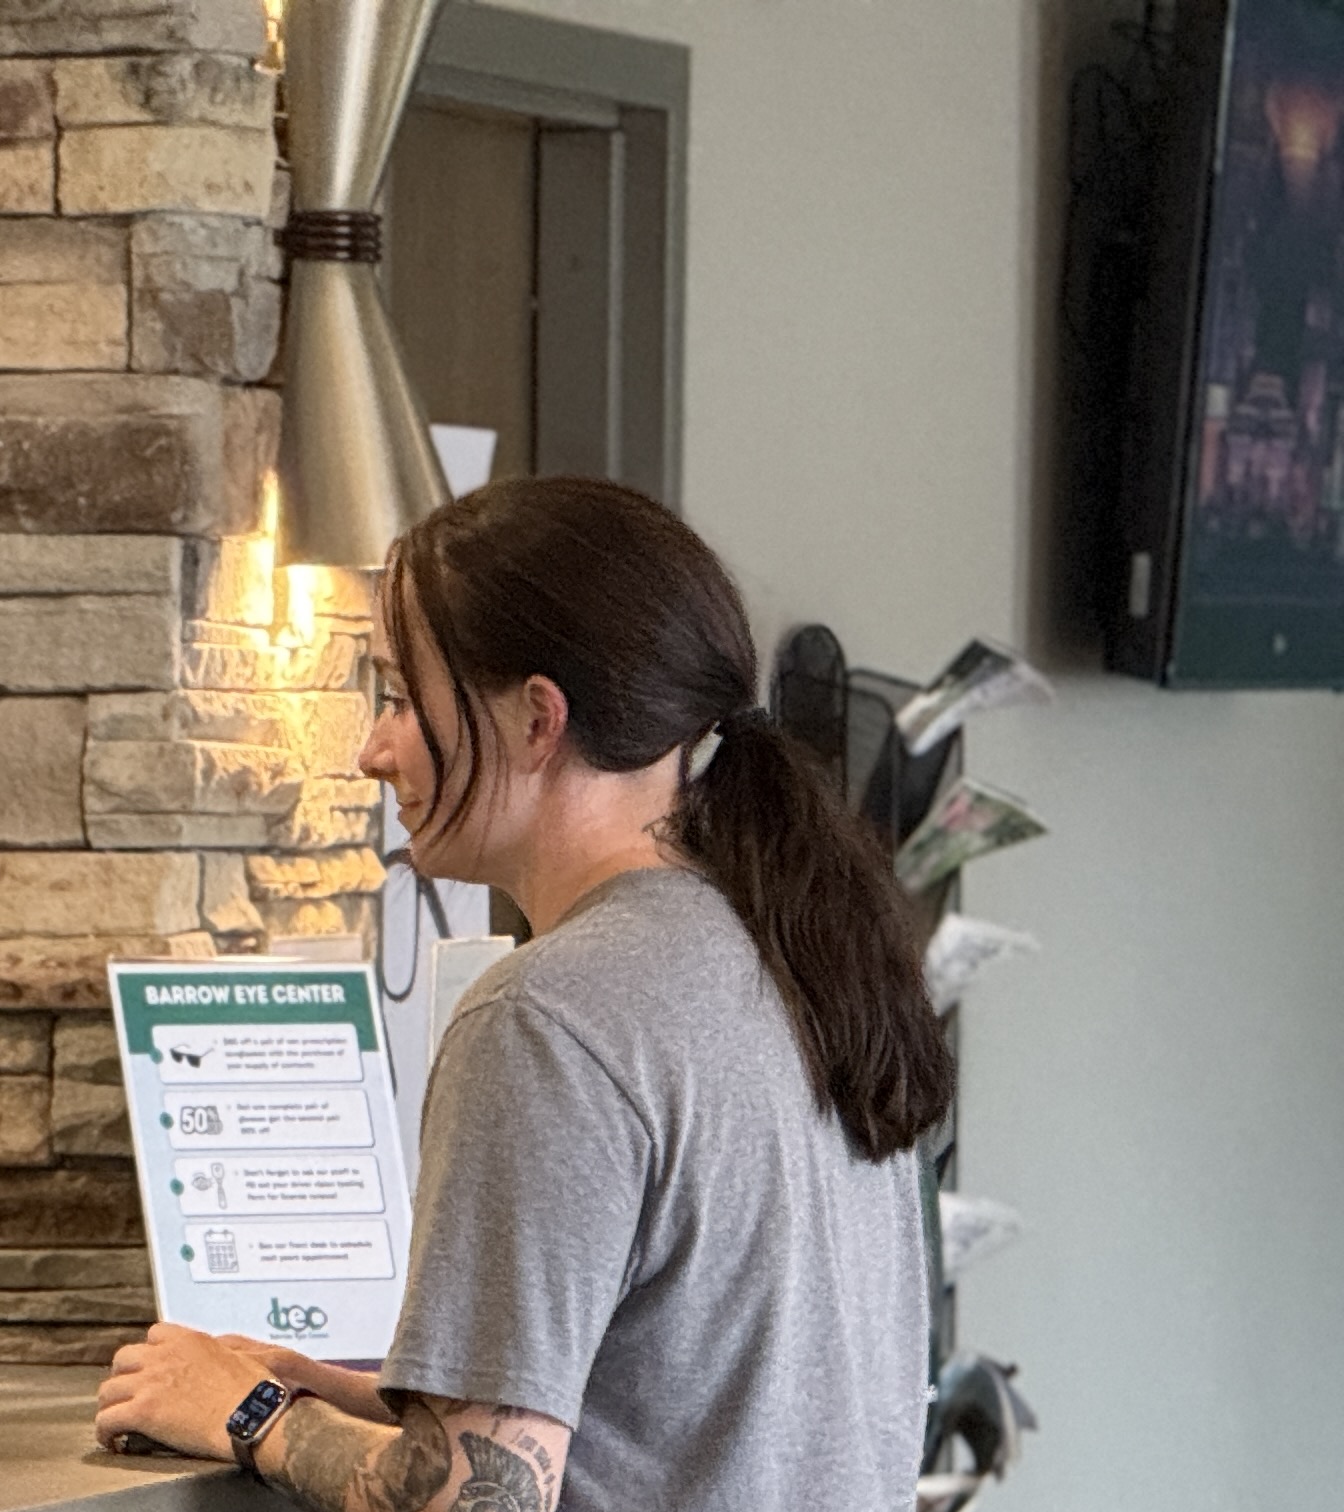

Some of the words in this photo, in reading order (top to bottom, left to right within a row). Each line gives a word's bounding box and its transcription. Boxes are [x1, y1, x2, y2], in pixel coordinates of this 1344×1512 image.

[145, 985, 231, 1006] BARROW
[234, 984, 269, 1005] EYE
[271, 983, 346, 1004] CENTER
